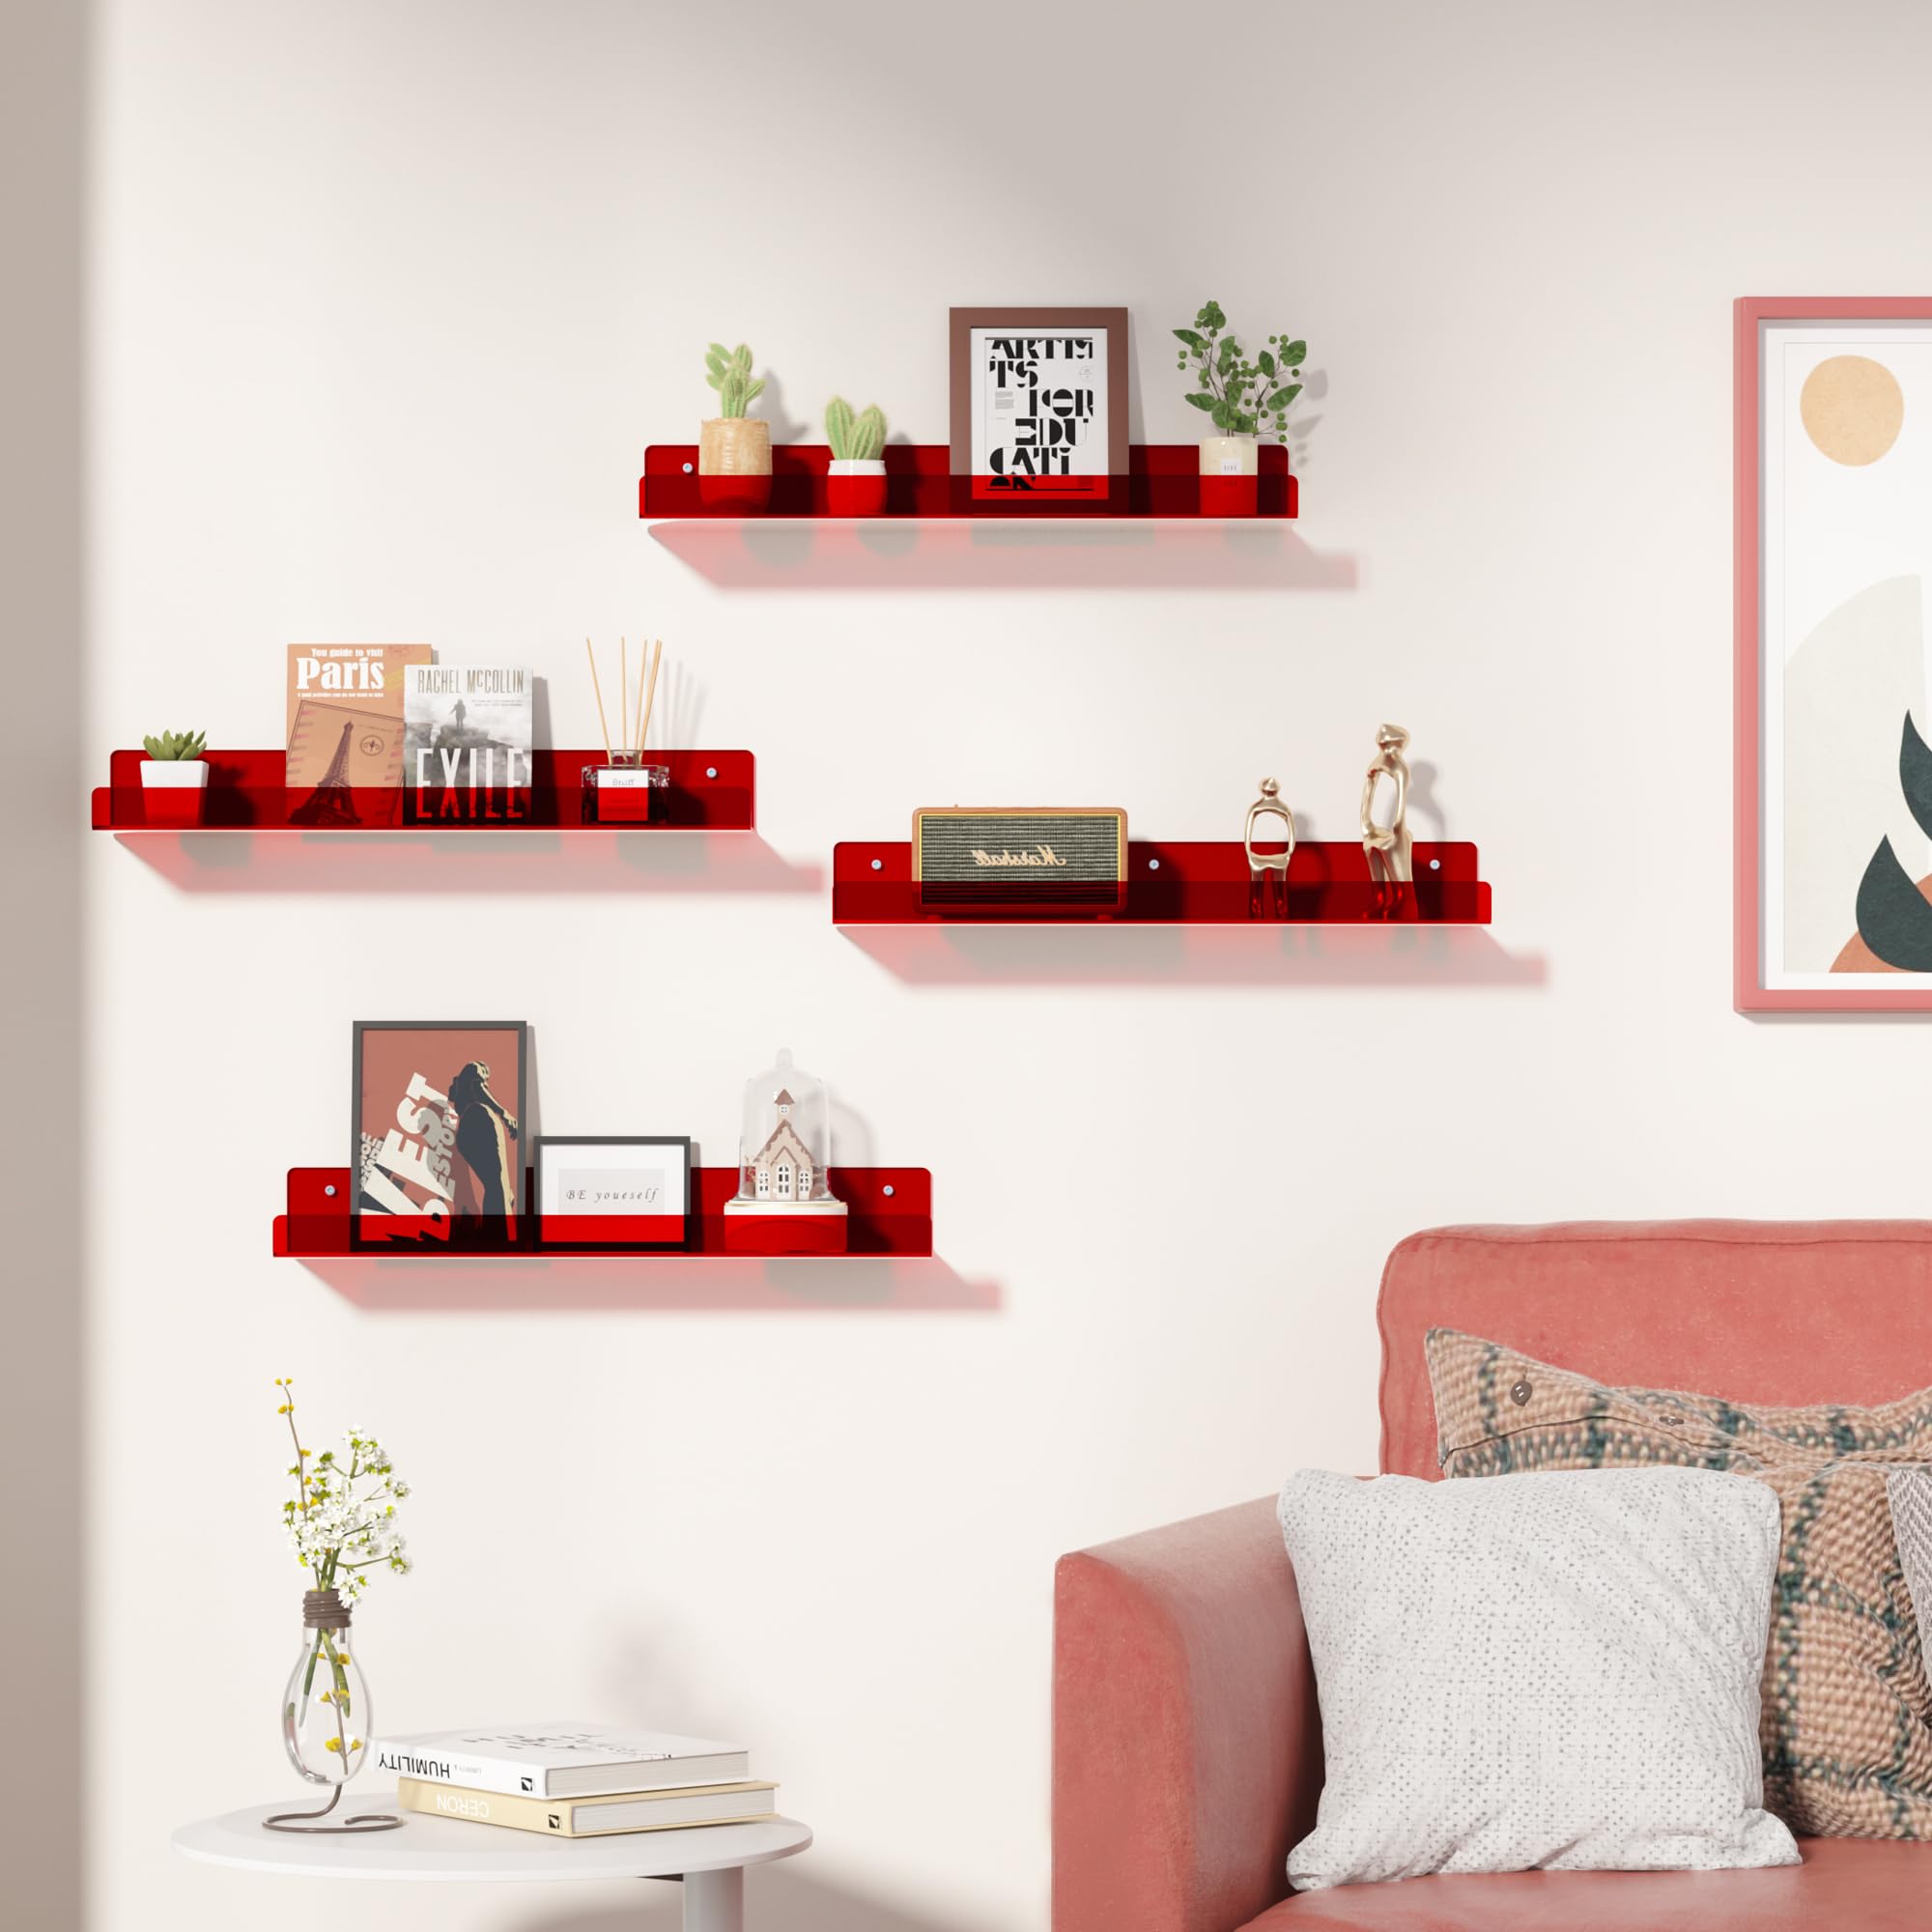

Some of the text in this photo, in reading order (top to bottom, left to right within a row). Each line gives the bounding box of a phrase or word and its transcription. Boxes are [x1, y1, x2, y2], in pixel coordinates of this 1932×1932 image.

[311, 648, 327, 658] You
[296, 656, 385, 690] Paris
[417, 669, 462, 694] RACHEL
[416, 748, 524, 818] EXILE
[566, 1189, 587, 1200] BE
[379, 1752, 450, 1778] HUMILITY
[436, 1792, 490, 1818] CERON
